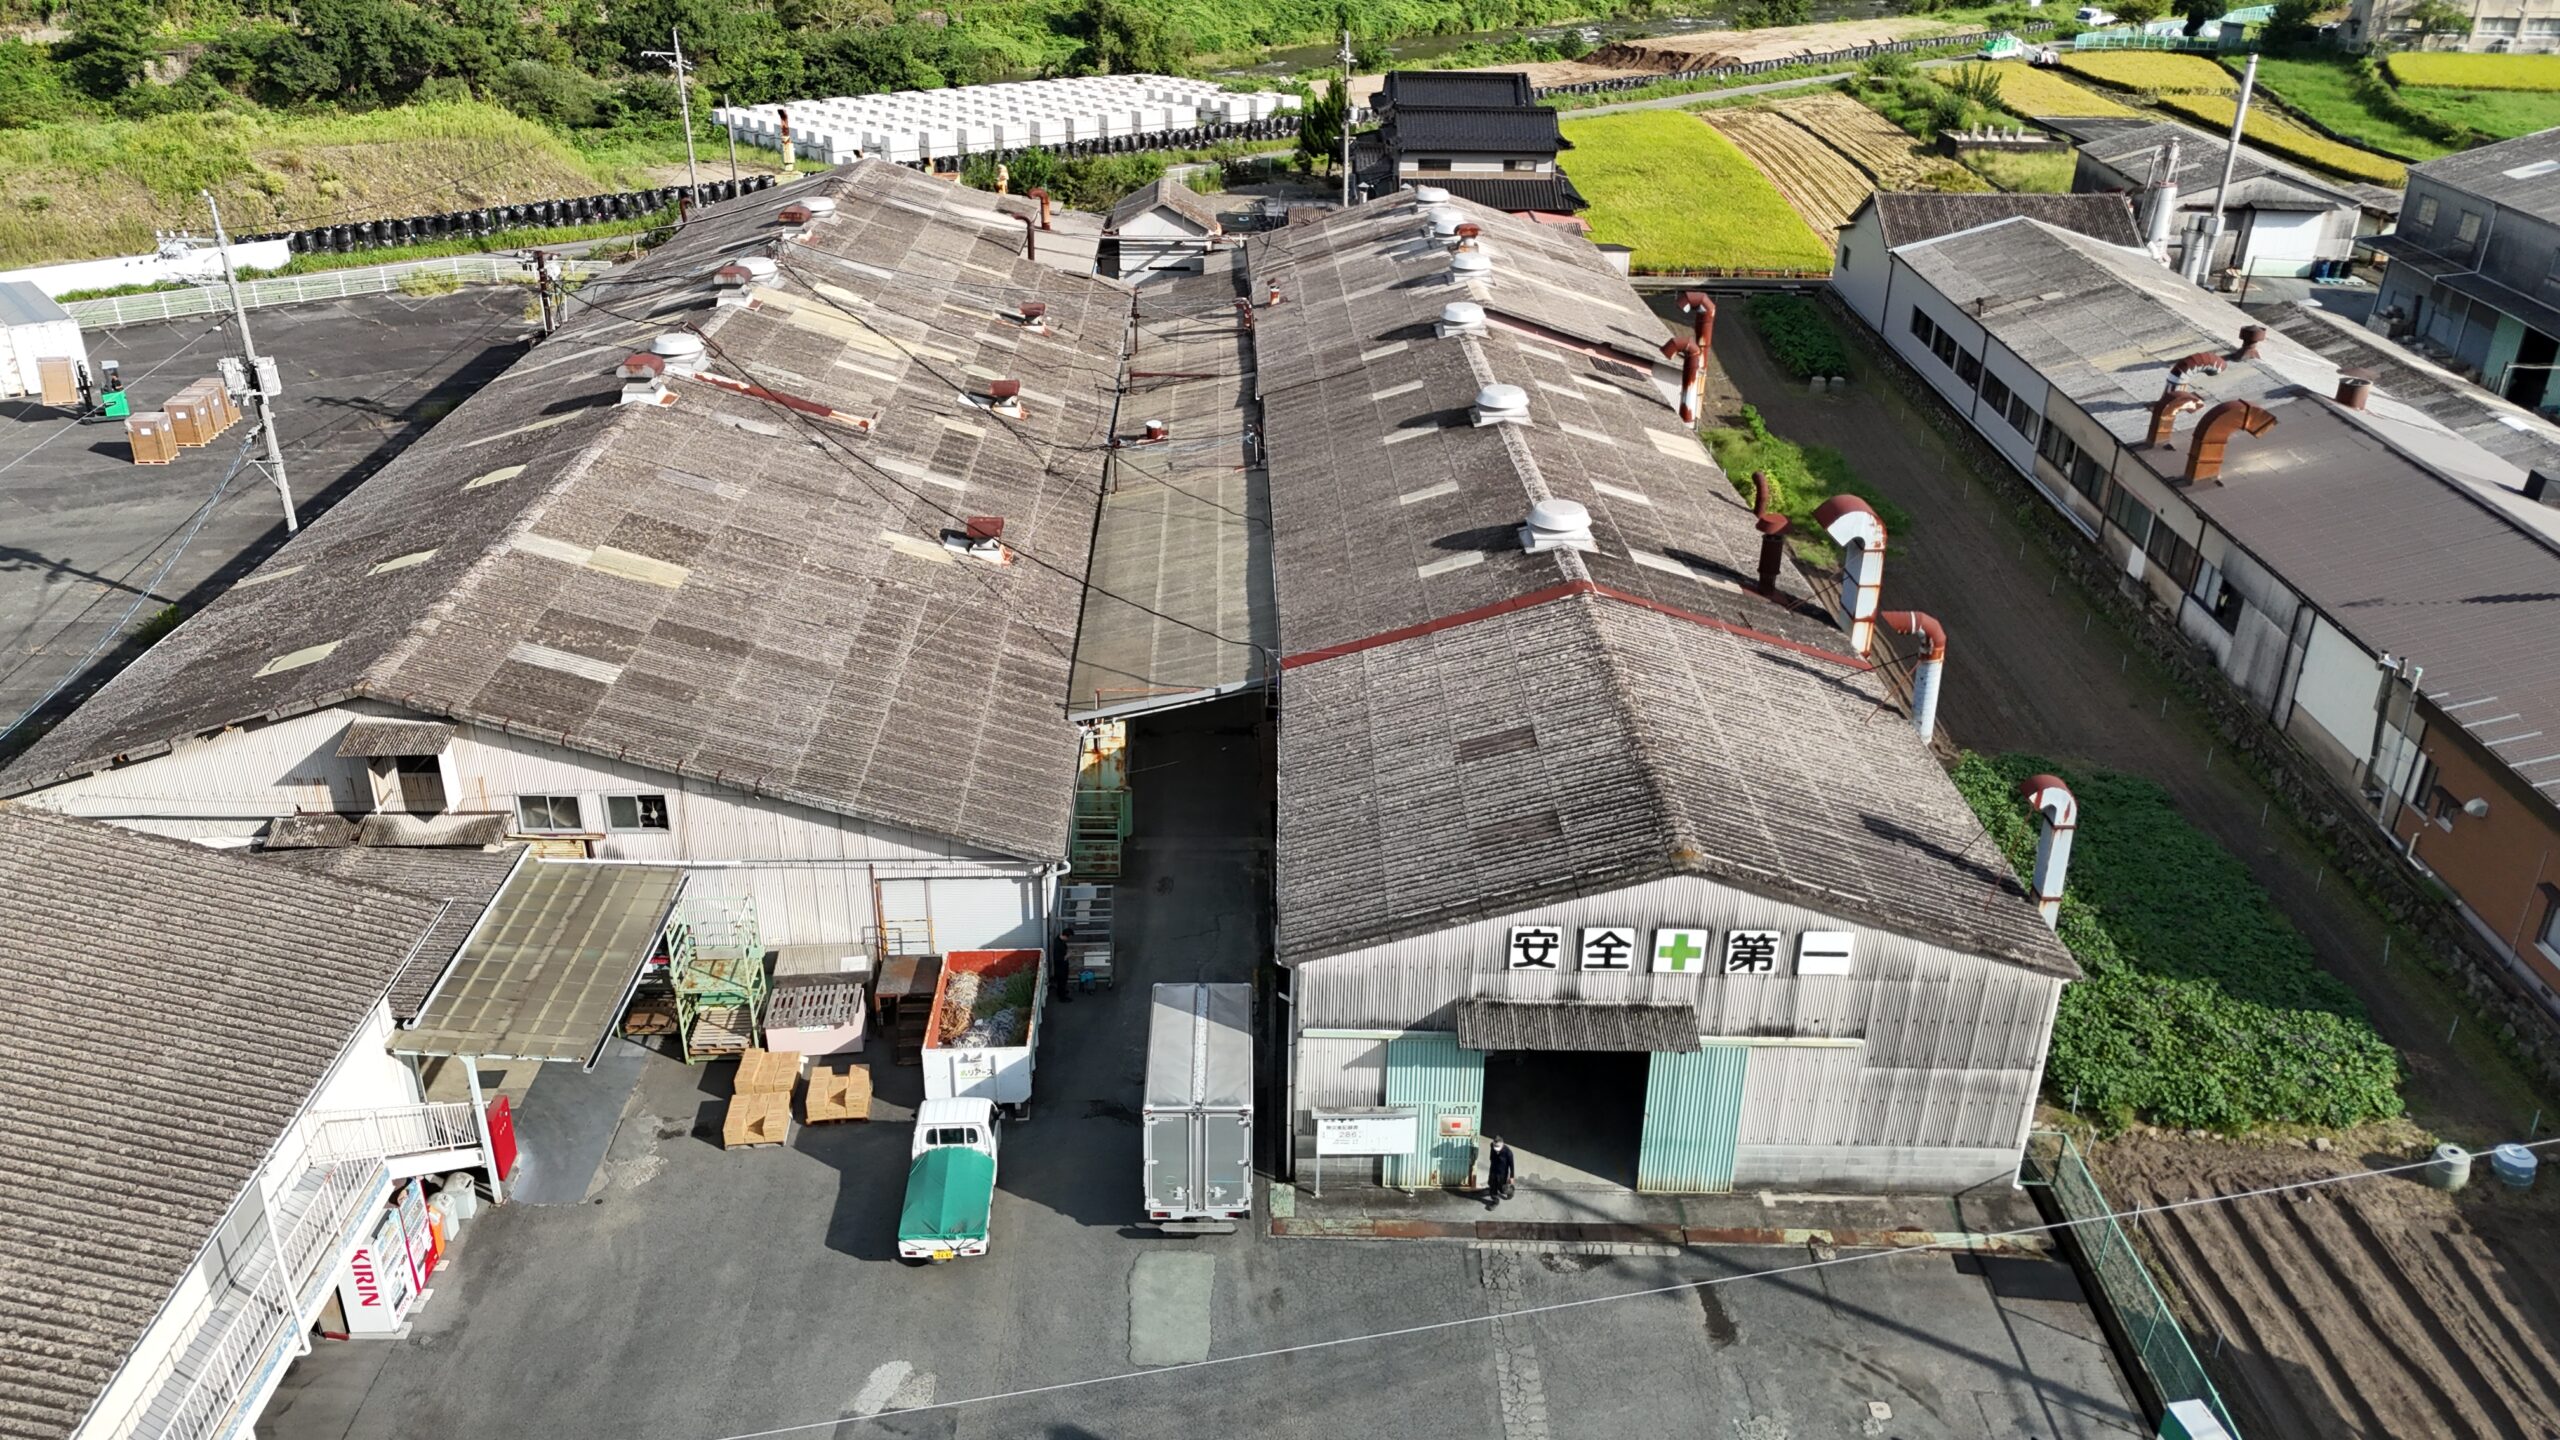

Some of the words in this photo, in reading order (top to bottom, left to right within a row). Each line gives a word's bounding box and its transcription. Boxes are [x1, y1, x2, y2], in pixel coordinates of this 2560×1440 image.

[1513, 928, 1849, 972] 安全第一
[351, 1249, 382, 1306] KIRIN
